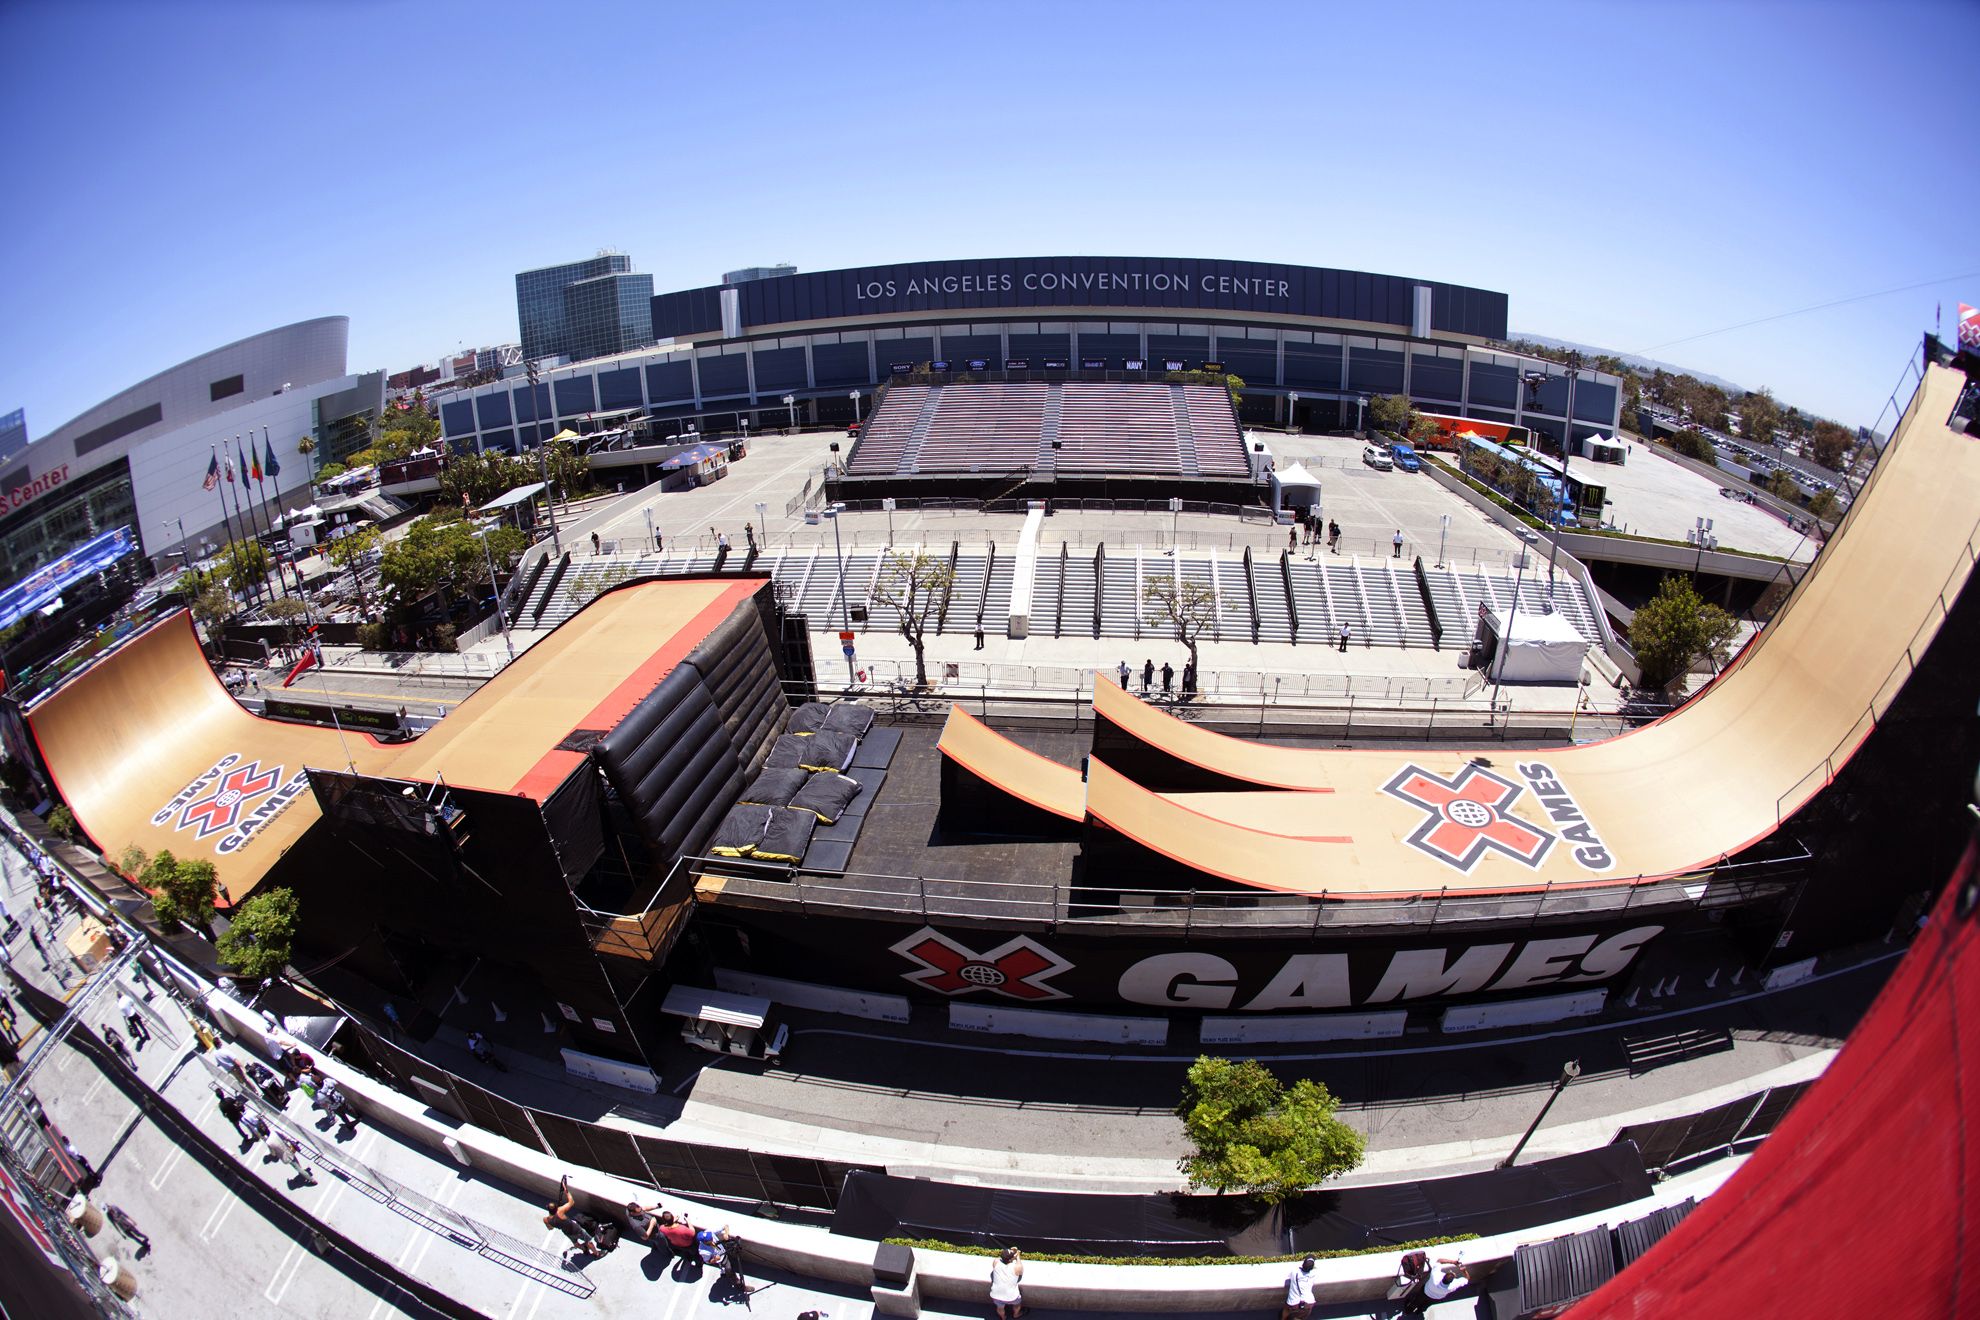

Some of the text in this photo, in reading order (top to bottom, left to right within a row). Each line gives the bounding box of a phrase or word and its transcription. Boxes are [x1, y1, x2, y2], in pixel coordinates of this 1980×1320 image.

[857, 273, 1290, 299] LOS ANGELES CONVENTION CENTER
[1126, 361, 1143, 370] NAVY
[1166, 361, 1183, 371] NAVY
[11, 463, 69, 507] Center
[154, 754, 239, 823] GAMES
[219, 770, 309, 852] GAMES
[236, 836, 255, 853] LOS
[256, 800, 296, 835] ANGELES
[1517, 762, 1612, 870] GAMES
[1117, 925, 1664, 1010] GAMES
